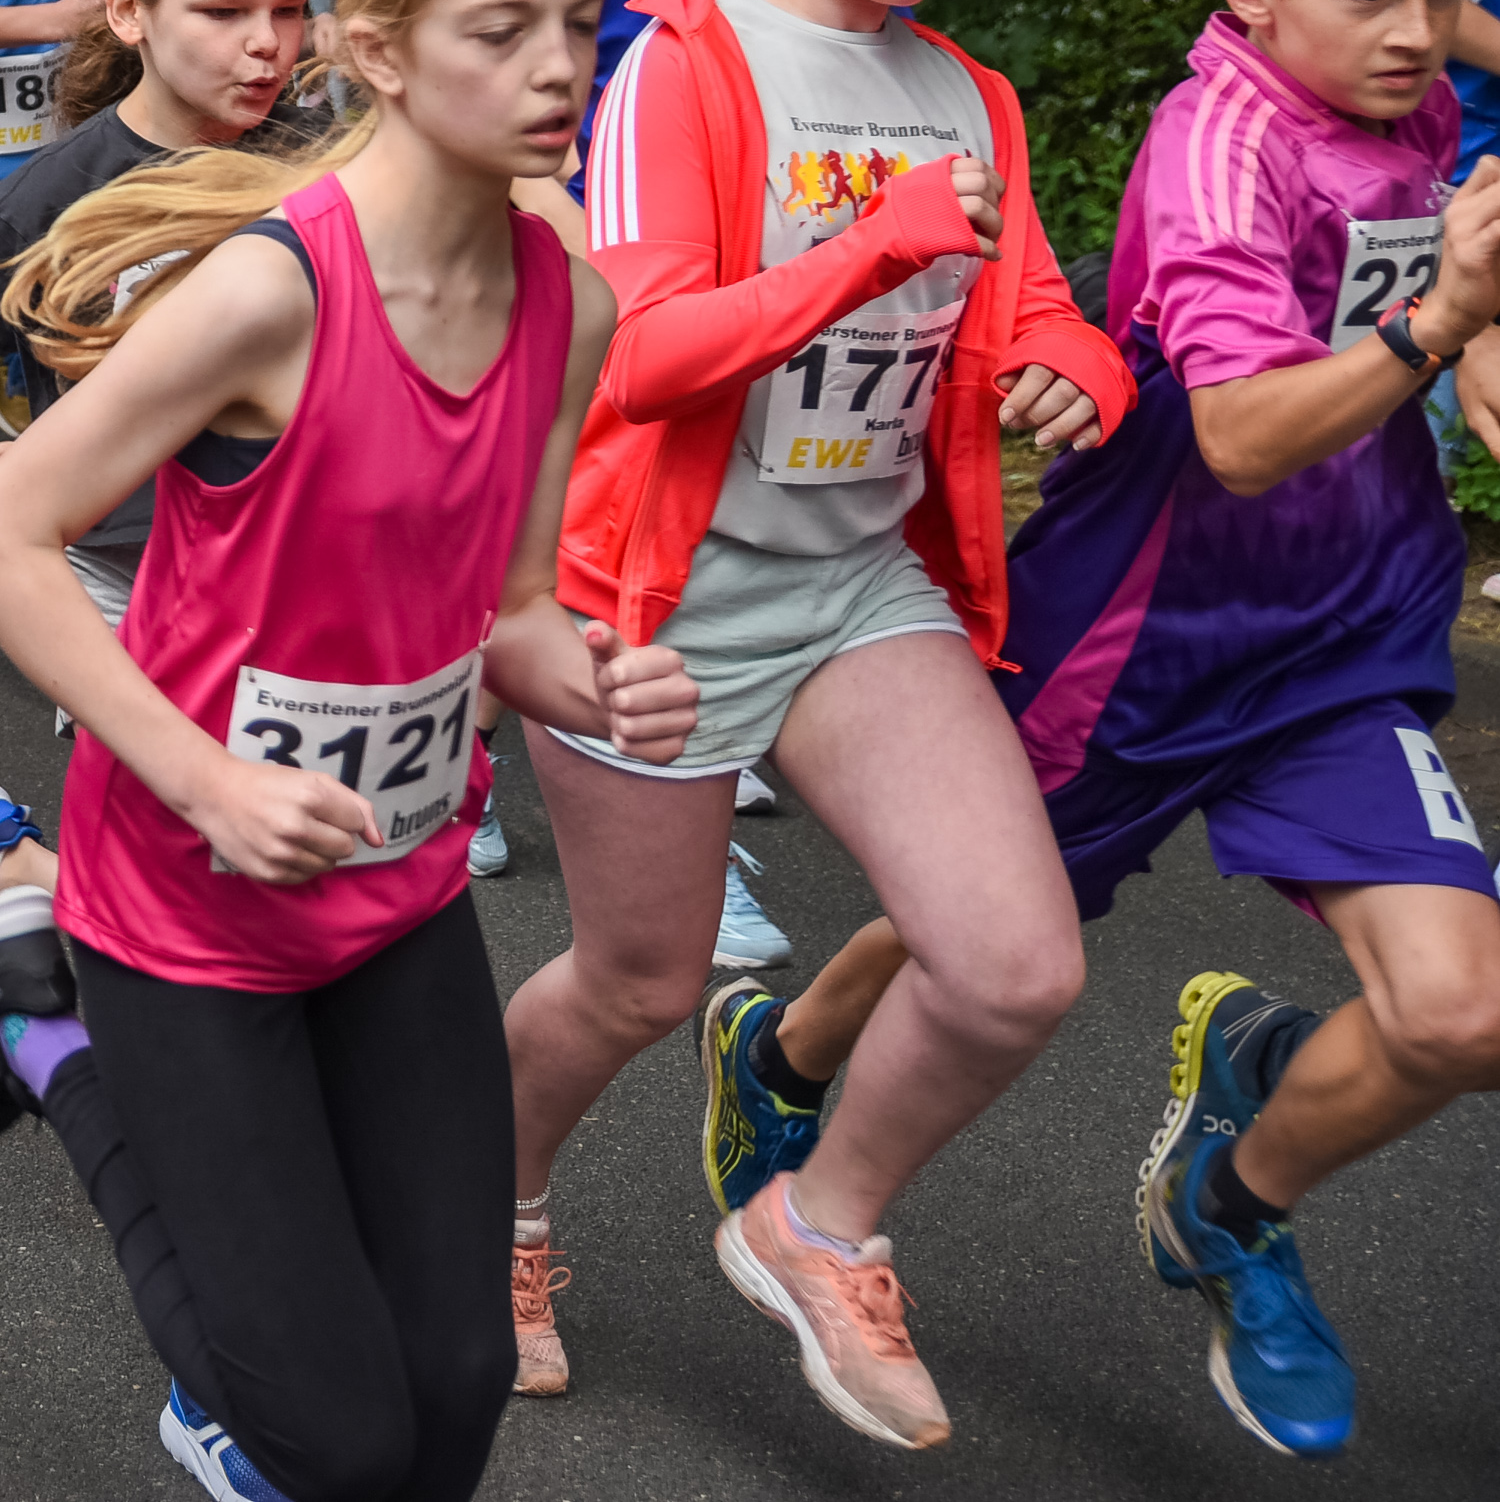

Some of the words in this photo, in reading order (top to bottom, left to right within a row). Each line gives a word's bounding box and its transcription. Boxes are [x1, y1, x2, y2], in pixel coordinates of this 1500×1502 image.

[790, 116, 864, 137] Everstener
[819, 326, 899, 342] erstener
[786, 437, 874, 469] EWE
[256, 688, 382, 717] Everstener
[241, 688, 470, 792] 3121
